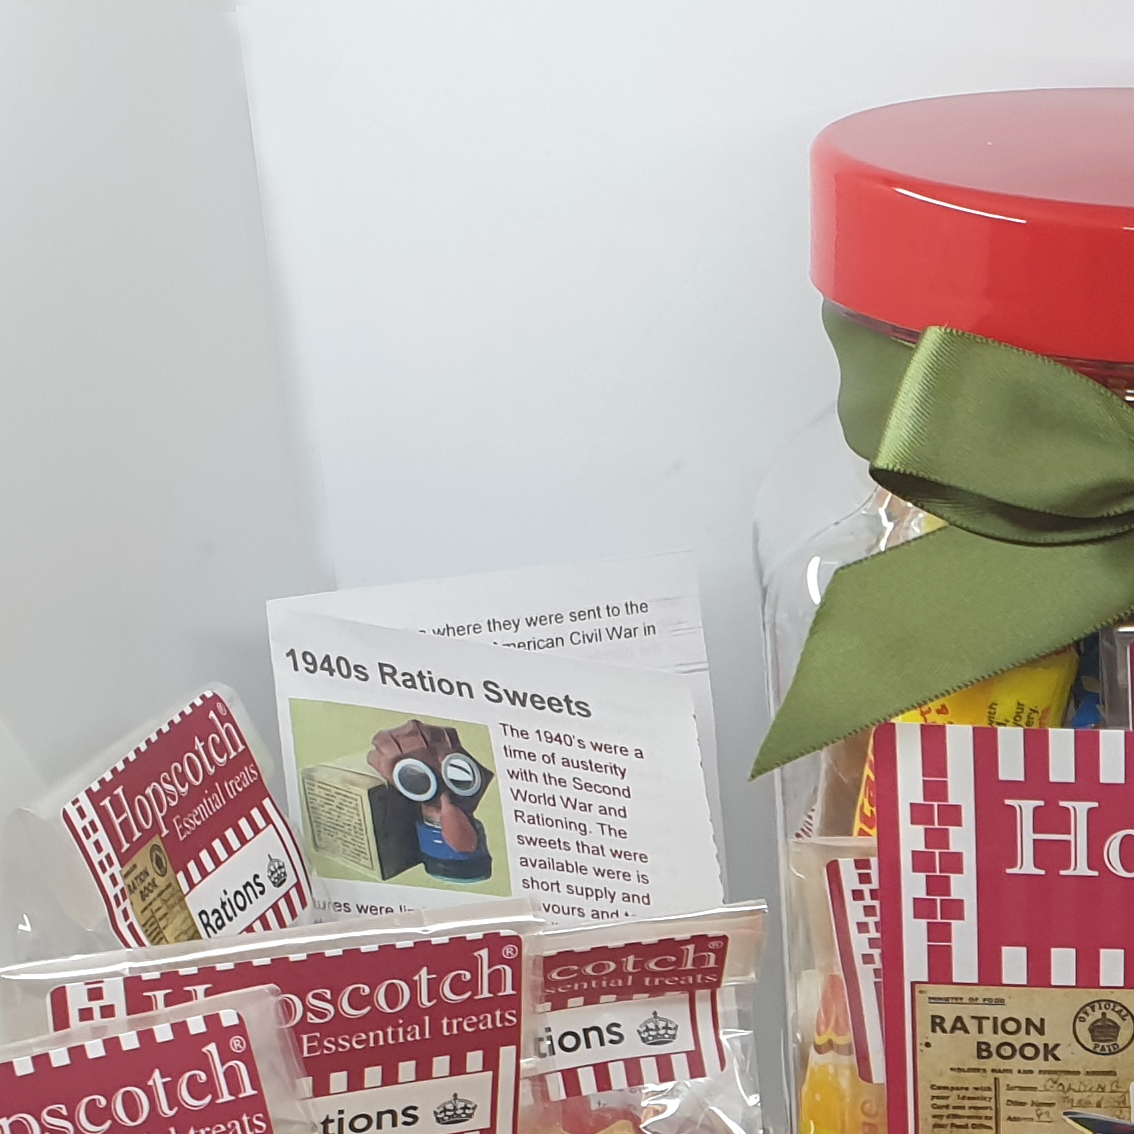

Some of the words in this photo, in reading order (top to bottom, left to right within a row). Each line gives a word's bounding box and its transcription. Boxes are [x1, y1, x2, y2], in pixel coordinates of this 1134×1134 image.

[432, 620, 483, 638] where
[487, 616, 521, 634] they
[525, 611, 565, 628] were
[569, 605, 602, 623] sent
[605, 602, 621, 618] to
[624, 600, 649, 615] the
[493, 634, 566, 651] erican
[569, 627, 603, 646] Civil
[606, 624, 639, 642] War
[643, 622, 657, 636] in
[285, 647, 370, 683] 1940s
[378, 661, 475, 699] Ration
[482, 678, 593, 719] Sweets
[499, 721, 530, 740] The
[534, 728, 587, 750] 1940's
[590, 739, 630, 758] were
[634, 748, 646, 760] a
[503, 744, 537, 762] time
[541, 751, 557, 766] of
[561, 755, 628, 781] austerity
[506, 767, 539, 784] with
[542, 771, 568, 788] the
[572, 776, 632, 799] Second
[171, 787, 227, 843] Essential
[224, 762, 259, 800] treats
[510, 787, 557, 808] World
[559, 794, 594, 813] War
[598, 803, 628, 819] and
[514, 809, 593, 837] Rationing.
[596, 821, 629, 839] The
[516, 833, 572, 852] sweets
[575, 840, 606, 858] that
[609, 847, 649, 863] were
[519, 855, 589, 876] available
[592, 865, 633, 882] were
[636, 870, 650, 885] is
[198, 872, 267, 939] Rations
[522, 876, 562, 894] short
[566, 883, 617, 904] supply
[621, 890, 651, 906] and
[644, 969, 721, 989] treats
[301, 1018, 432, 1059] Essential
[441, 1005, 519, 1036] treats
[930, 1014, 1046, 1036] RATION
[976, 1041, 1063, 1062] BOOK
[1092, 1042, 1120, 1053] PAID
